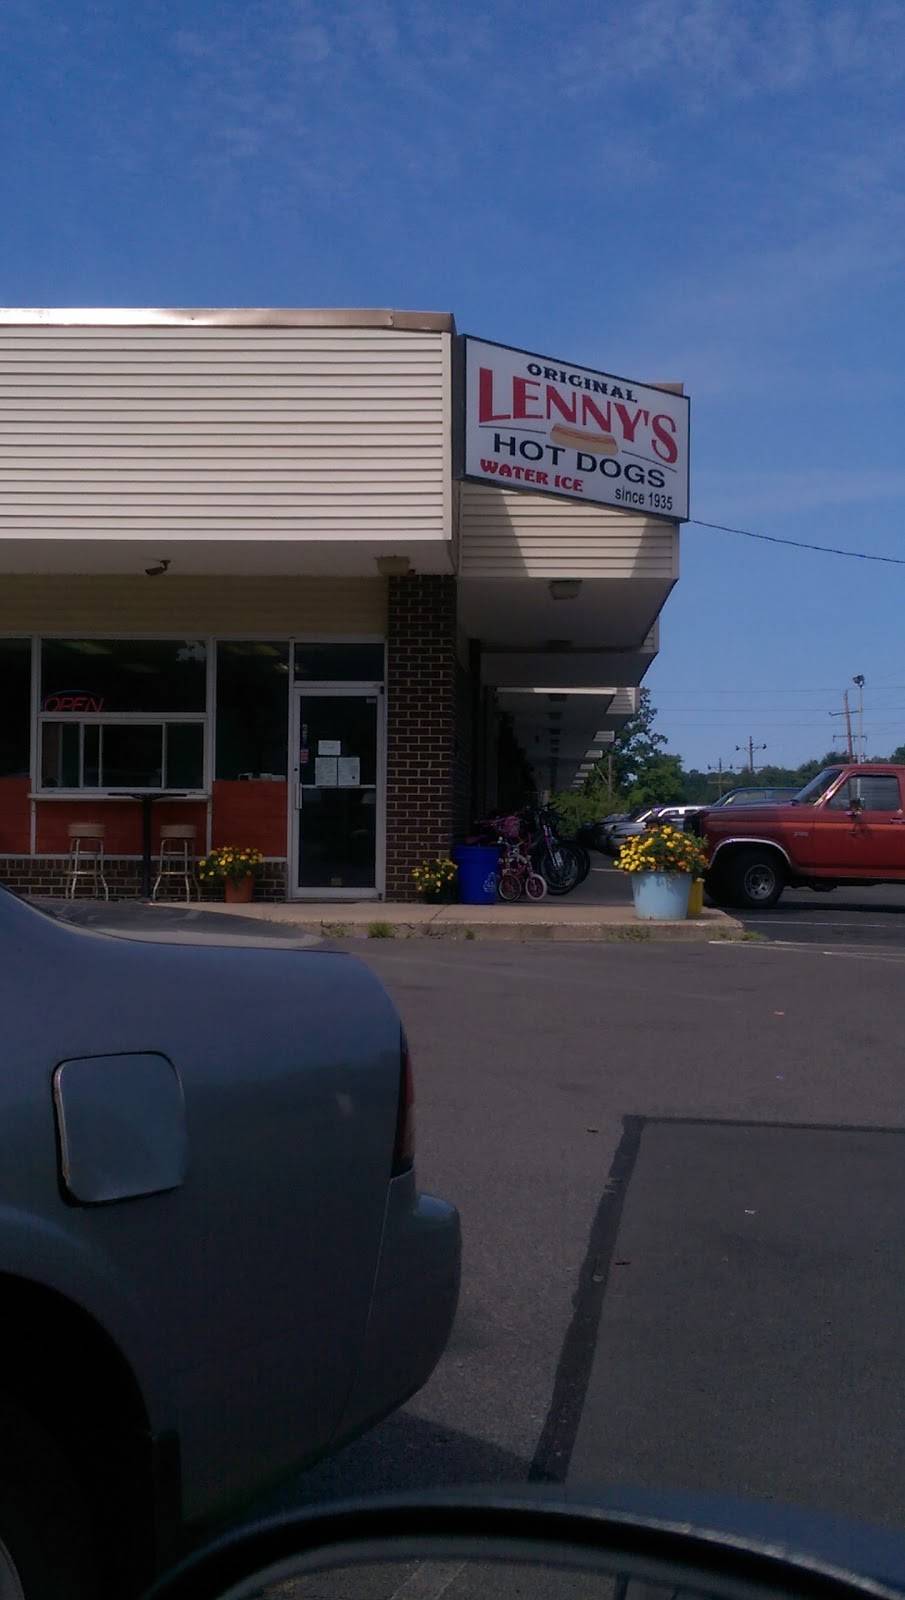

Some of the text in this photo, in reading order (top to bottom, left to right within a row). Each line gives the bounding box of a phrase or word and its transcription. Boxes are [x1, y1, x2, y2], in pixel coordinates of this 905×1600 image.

[527, 363, 638, 403] ORIGINAL
[479, 367, 678, 464] LENNY'S
[480, 458, 584, 492] WATER ICE
[494, 433, 665, 488] HOT DOGS
[615, 487, 673, 511] since 1935
[43, 697, 105, 712] OPEN
